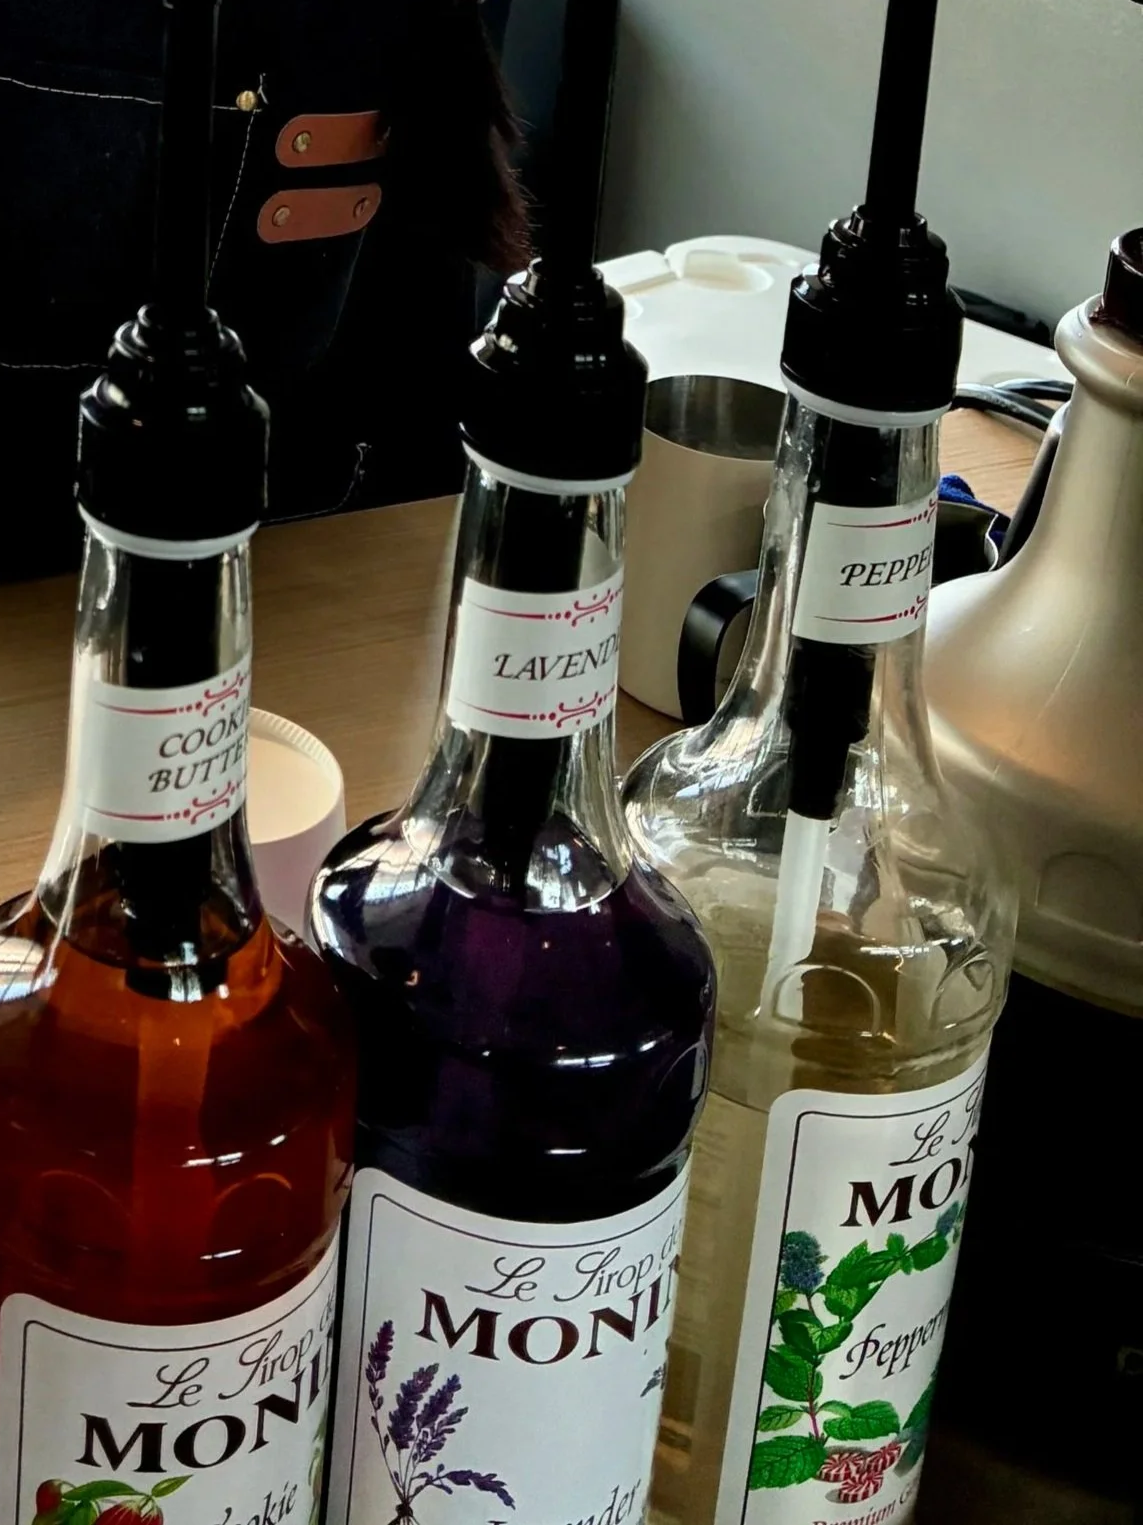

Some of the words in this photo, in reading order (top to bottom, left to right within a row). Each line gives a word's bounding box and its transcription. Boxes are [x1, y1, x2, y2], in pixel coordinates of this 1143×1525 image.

[888, 1111, 951, 1167] Le
[464, 1256, 546, 1302] Le
[553, 1246, 654, 1303] Sirop
[126, 1357, 210, 1408] Le
[217, 1329, 314, 1400] Sirop
